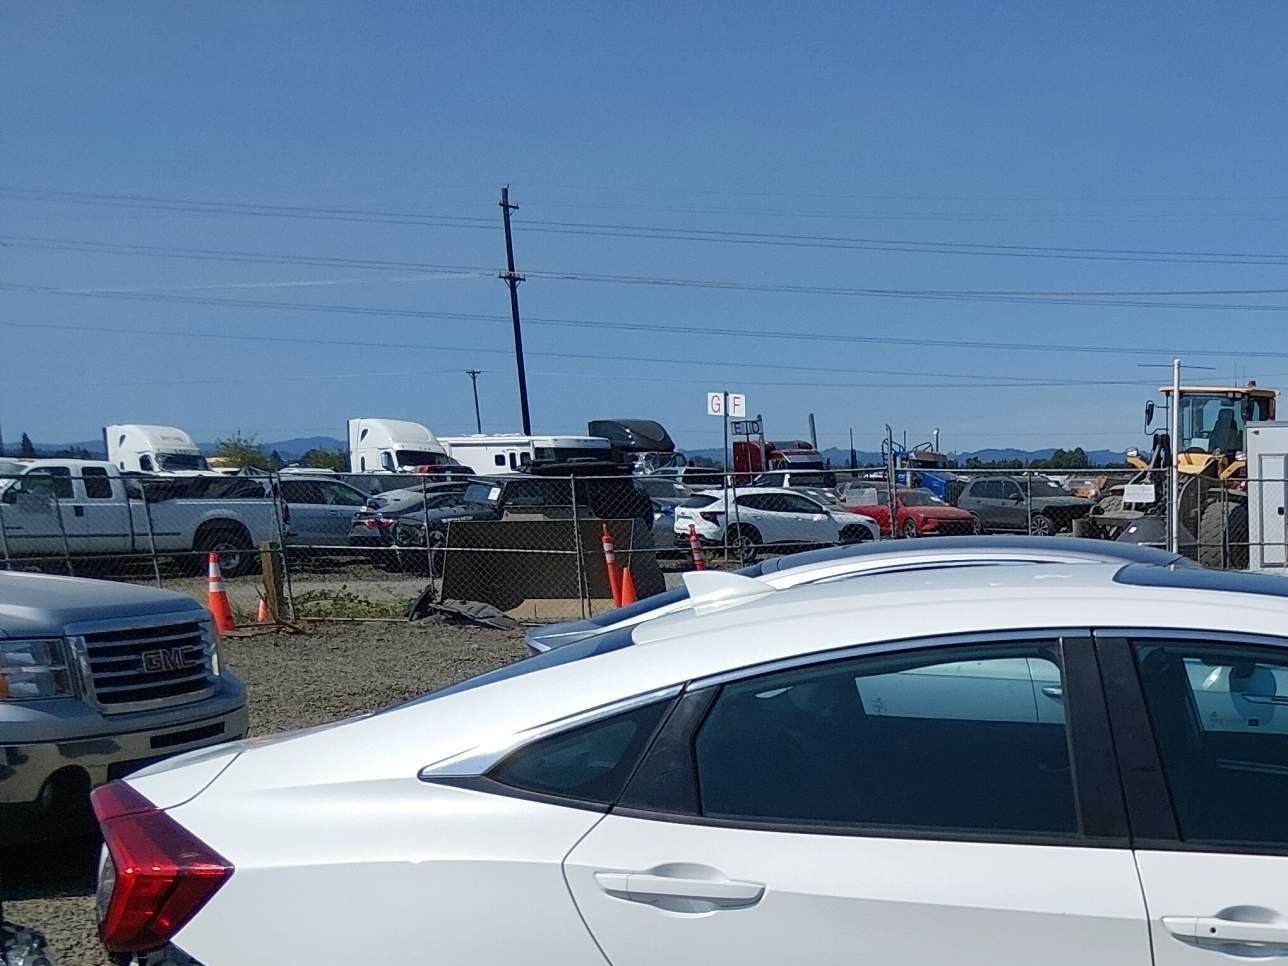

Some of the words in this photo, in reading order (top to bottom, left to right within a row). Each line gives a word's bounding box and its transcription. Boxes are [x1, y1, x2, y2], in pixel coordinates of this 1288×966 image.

[711, 395, 721, 413] G
[733, 396, 741, 414] F
[142, 645, 199, 673] GMC
